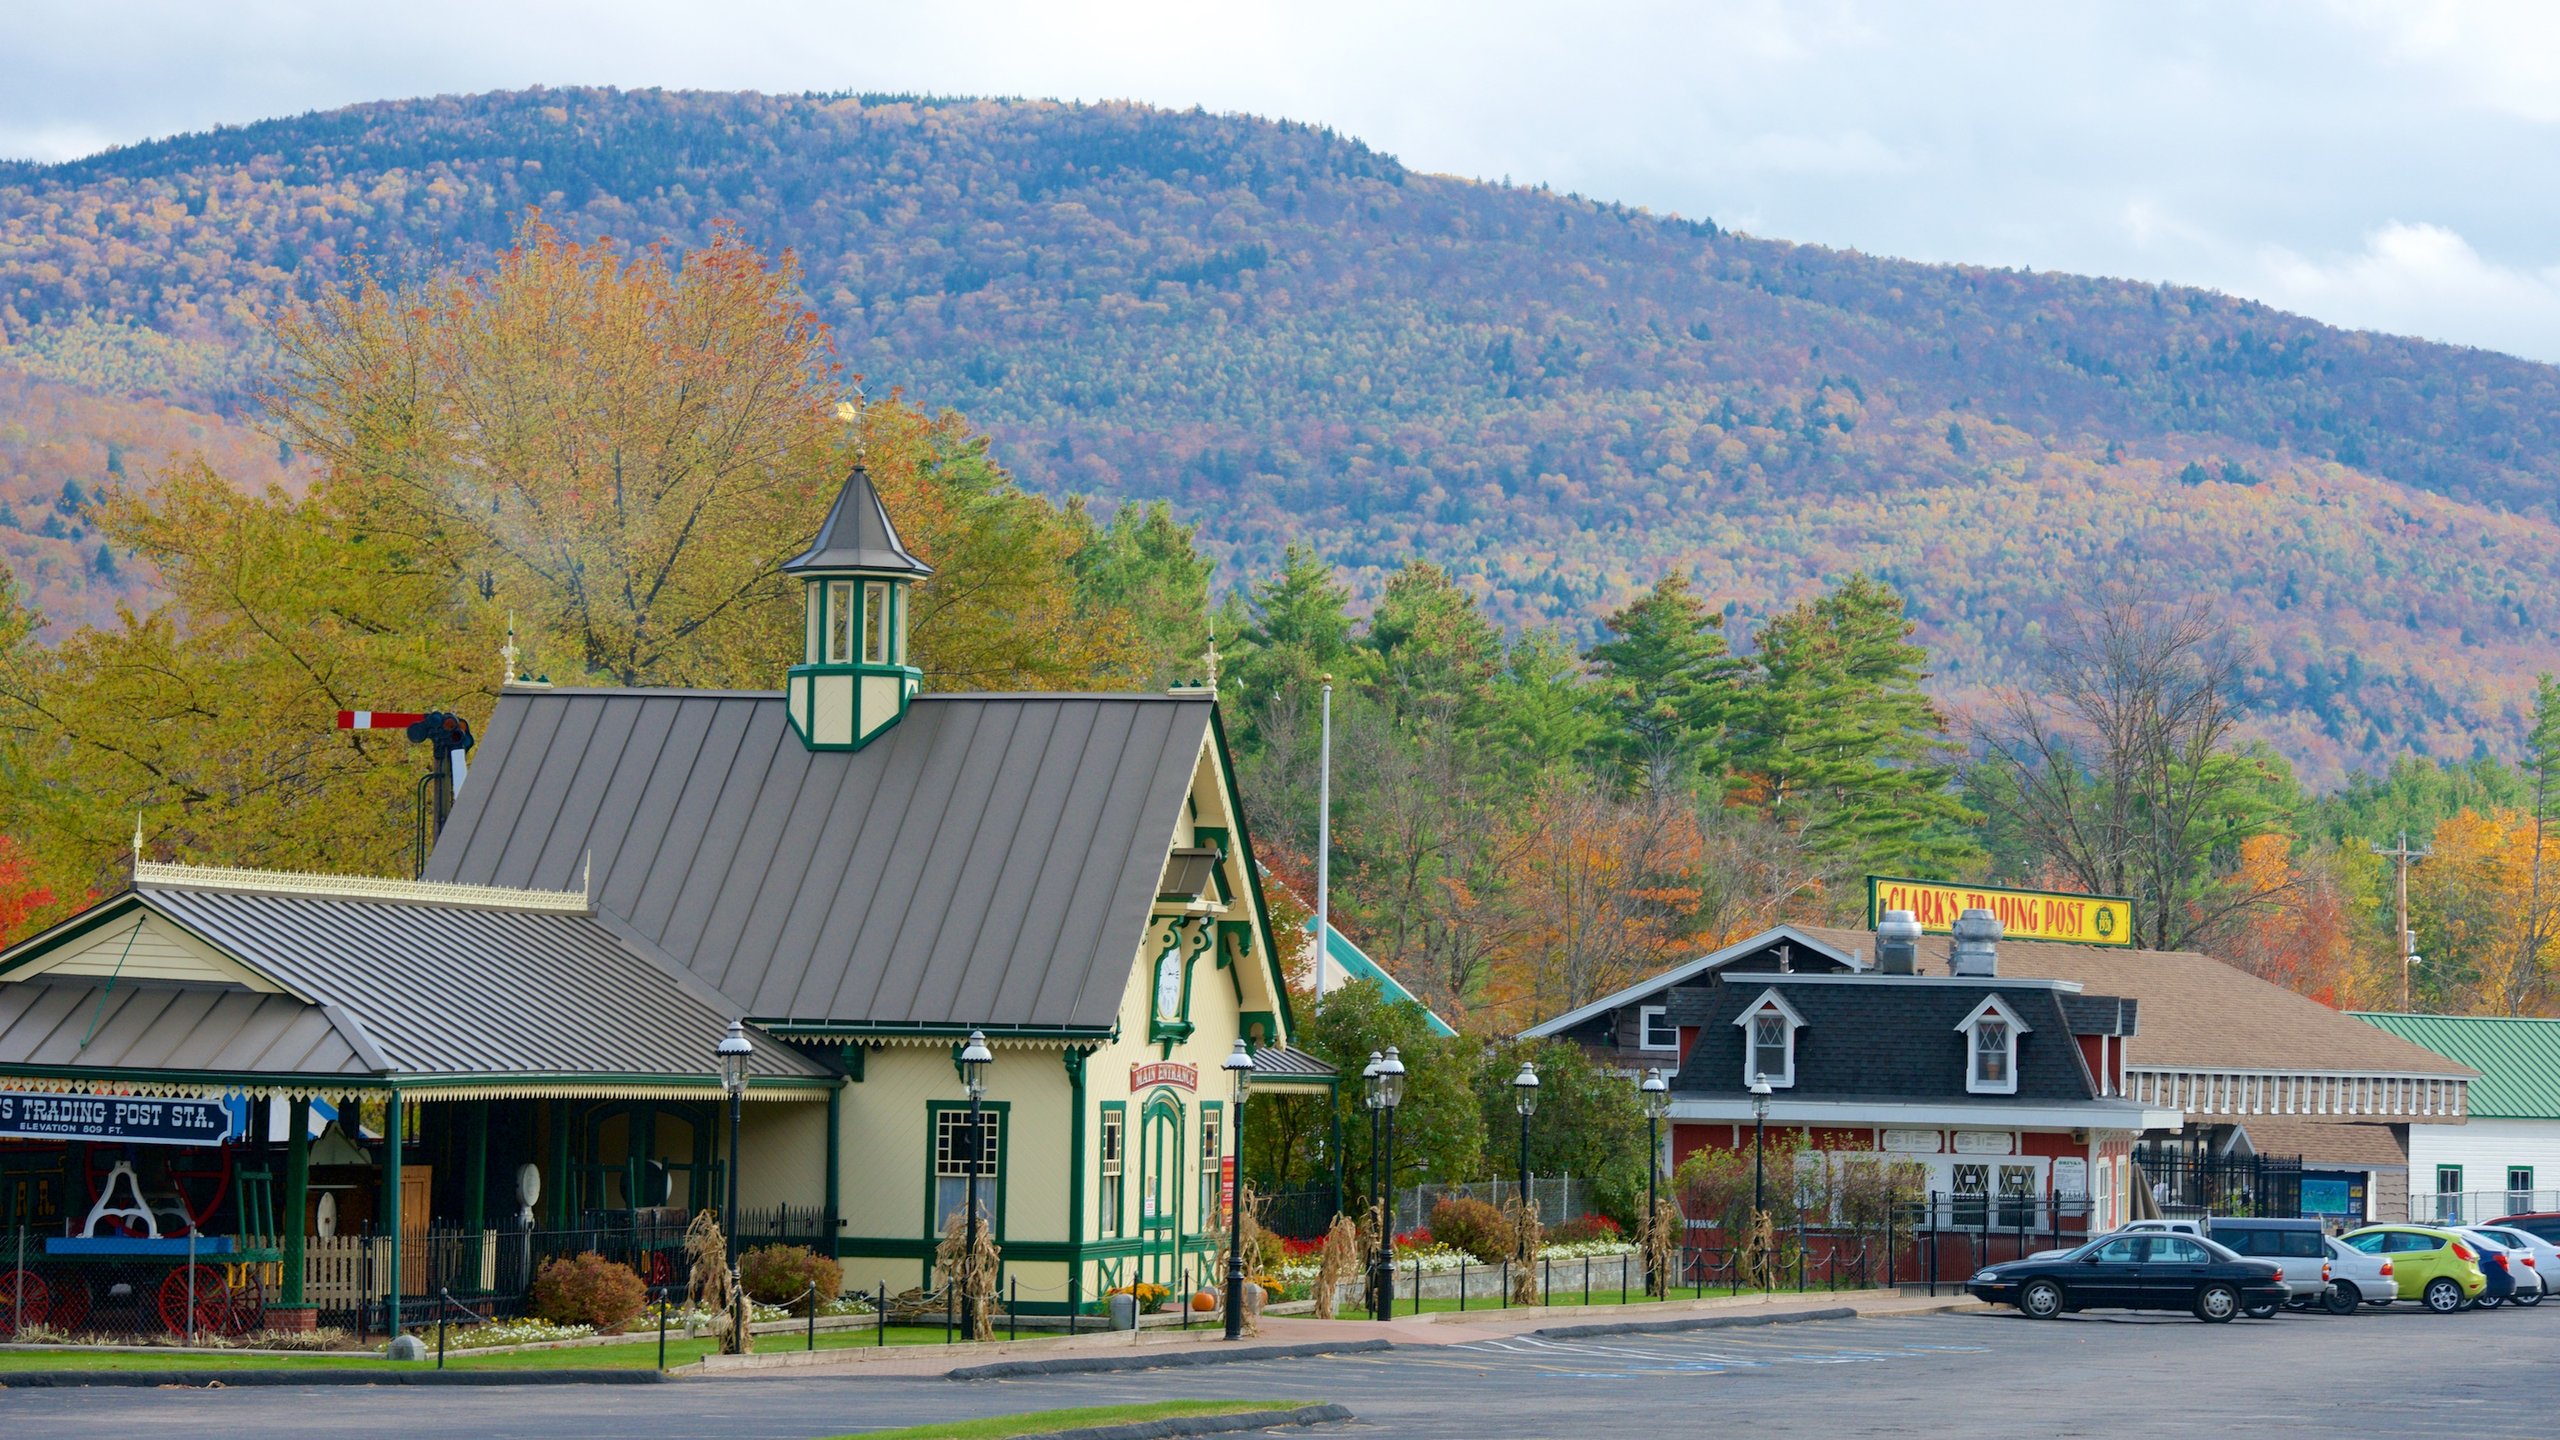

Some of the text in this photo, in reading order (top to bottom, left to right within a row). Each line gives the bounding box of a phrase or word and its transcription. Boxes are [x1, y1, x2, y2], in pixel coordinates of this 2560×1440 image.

[2045, 900, 2085, 936] POST
[1136, 1065, 1195, 1087] MAIN ENTRANCE
[22, 1099, 107, 1124] TRADING
[115, 1103, 162, 1126] POST
[172, 1106, 215, 1128] STA.
[20, 1122, 123, 1135] ELEVATION 809 FT.
